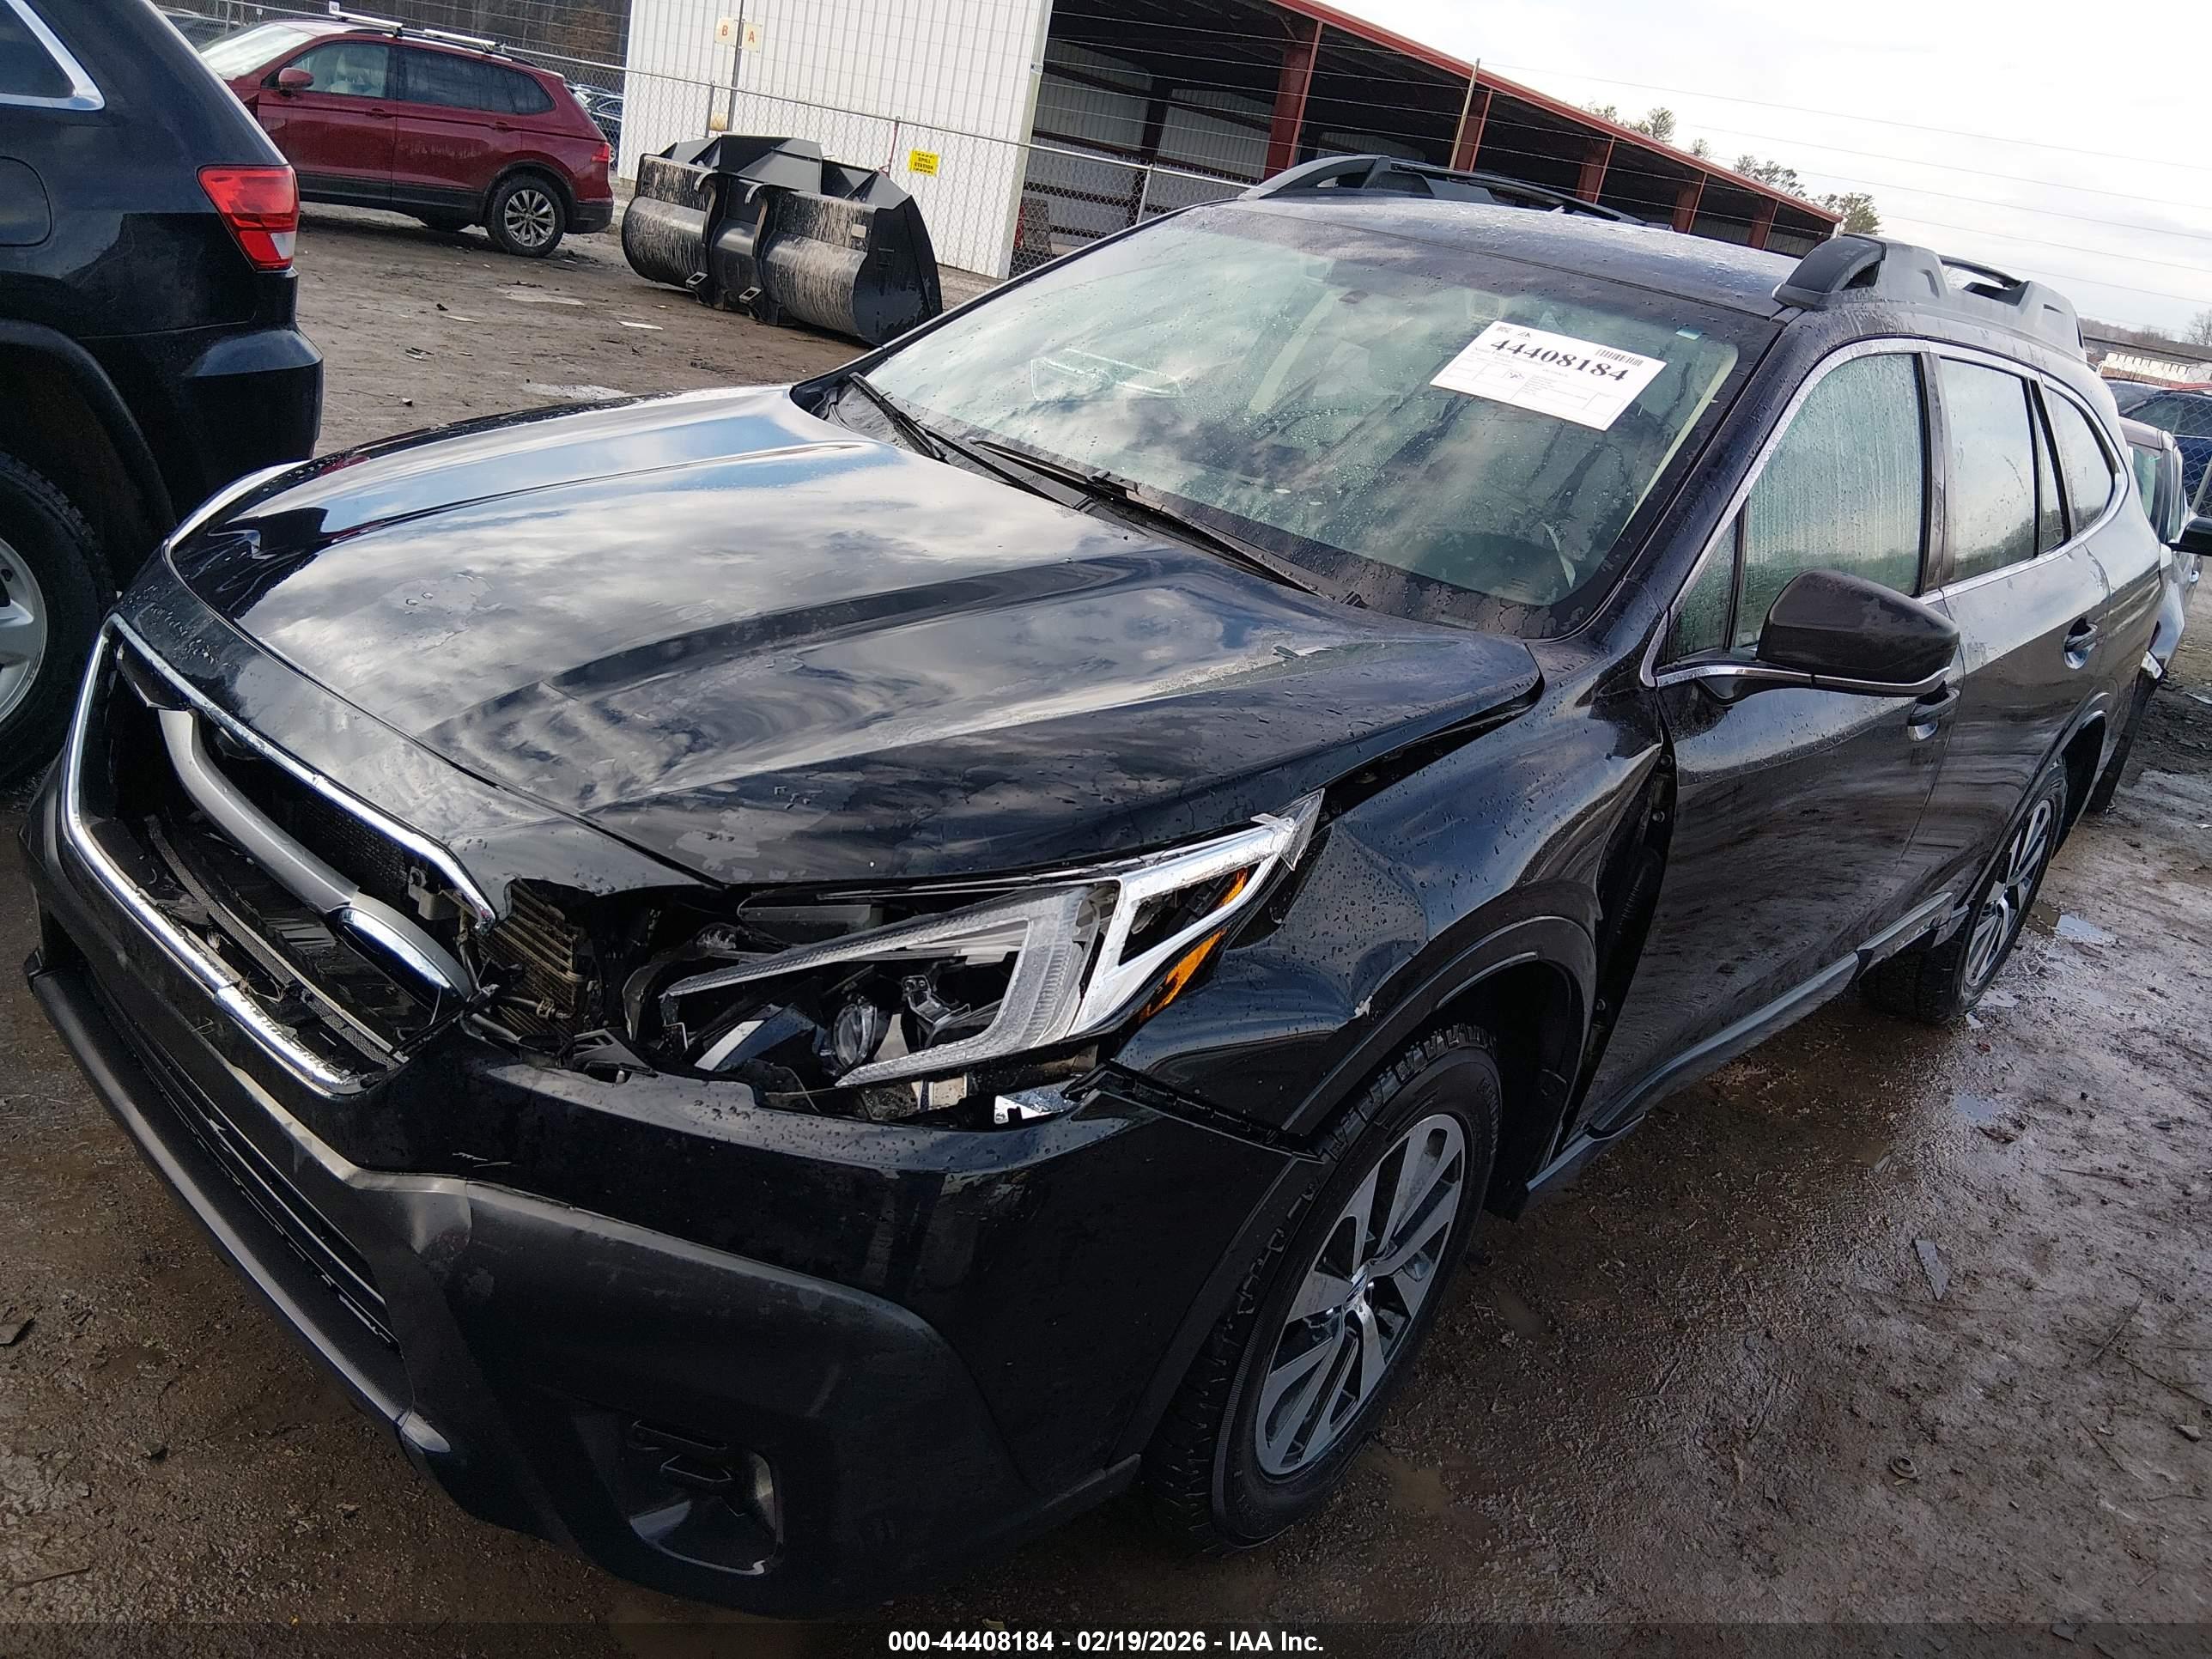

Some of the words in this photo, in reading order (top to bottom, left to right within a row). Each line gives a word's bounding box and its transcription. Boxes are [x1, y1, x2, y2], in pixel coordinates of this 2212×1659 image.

[721, 25, 729, 36] B
[748, 31, 755, 43] A
[914, 161, 934, 170] STATION
[1491, 339, 1629, 381] 44408184
